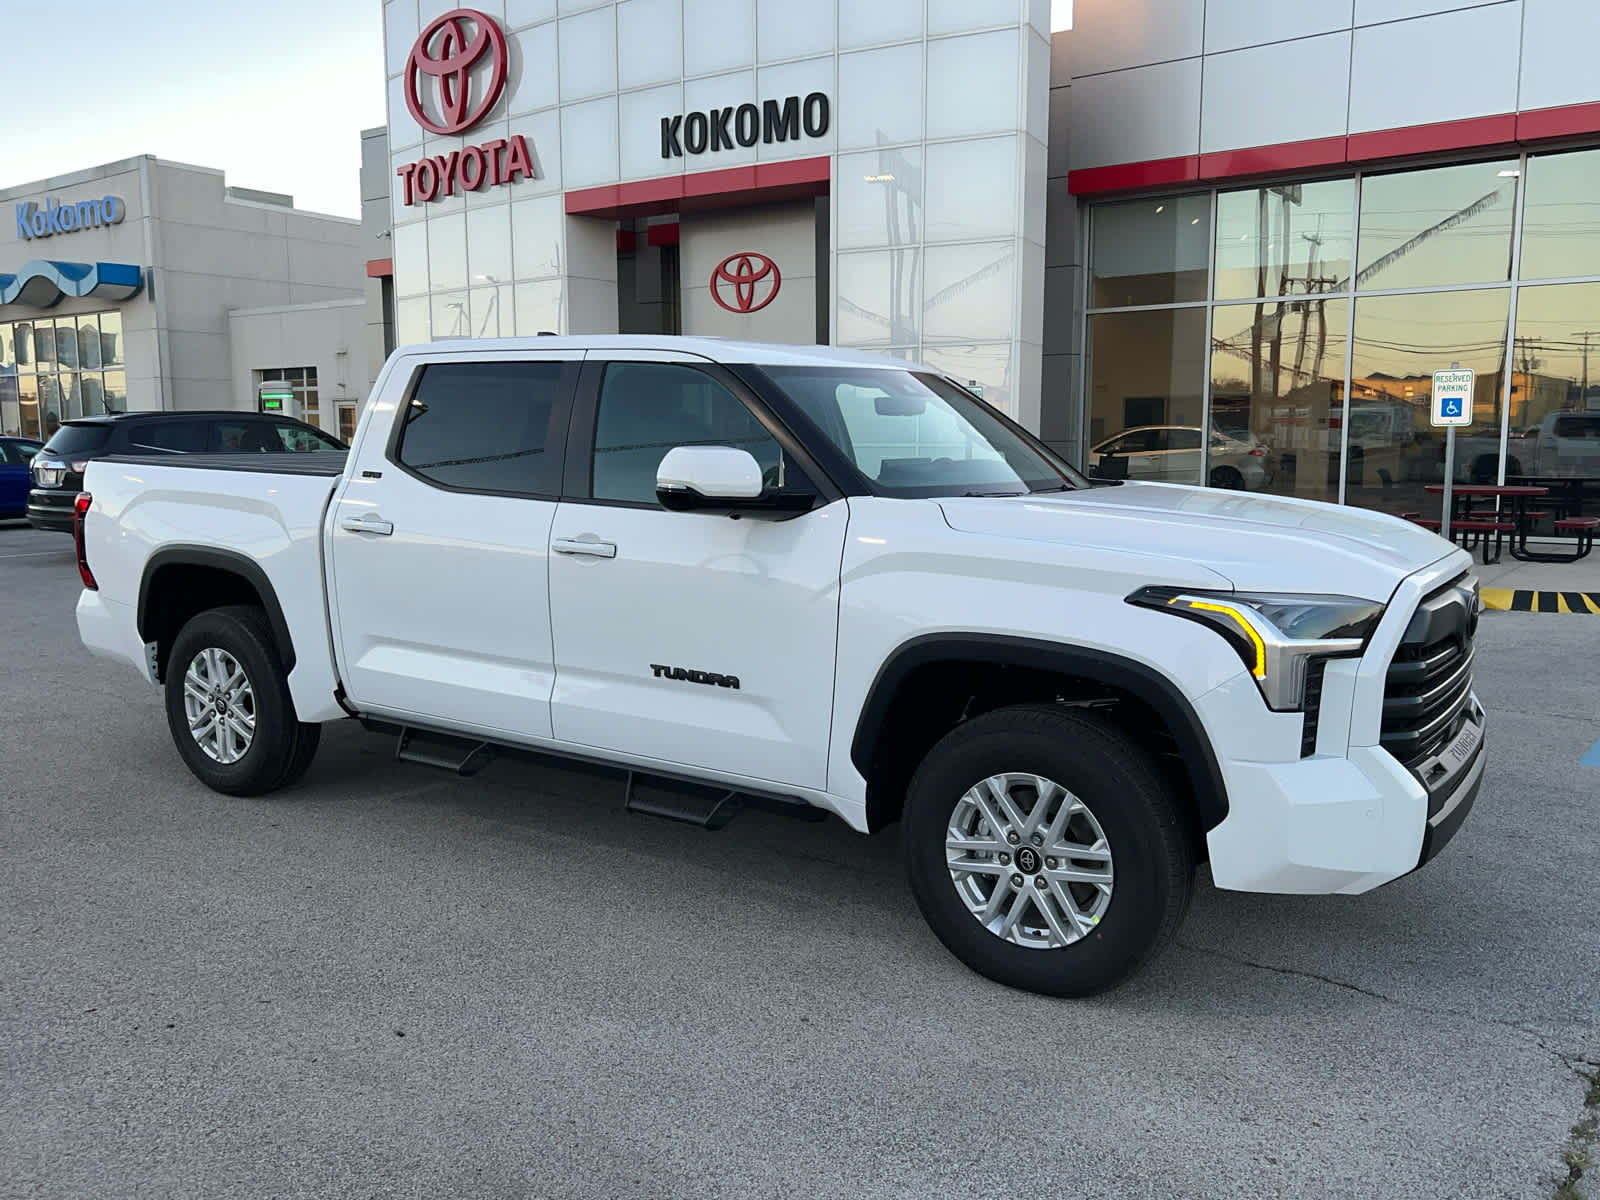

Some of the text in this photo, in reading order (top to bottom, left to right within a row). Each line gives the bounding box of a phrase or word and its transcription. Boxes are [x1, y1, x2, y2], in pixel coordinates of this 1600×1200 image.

[661, 92, 829, 158] KOKOMO
[397, 135, 533, 206] TOYOTA
[16, 195, 118, 239] Kokomo
[1438, 384, 1468, 392] PARKING
[650, 664, 740, 689] TUNDRA
